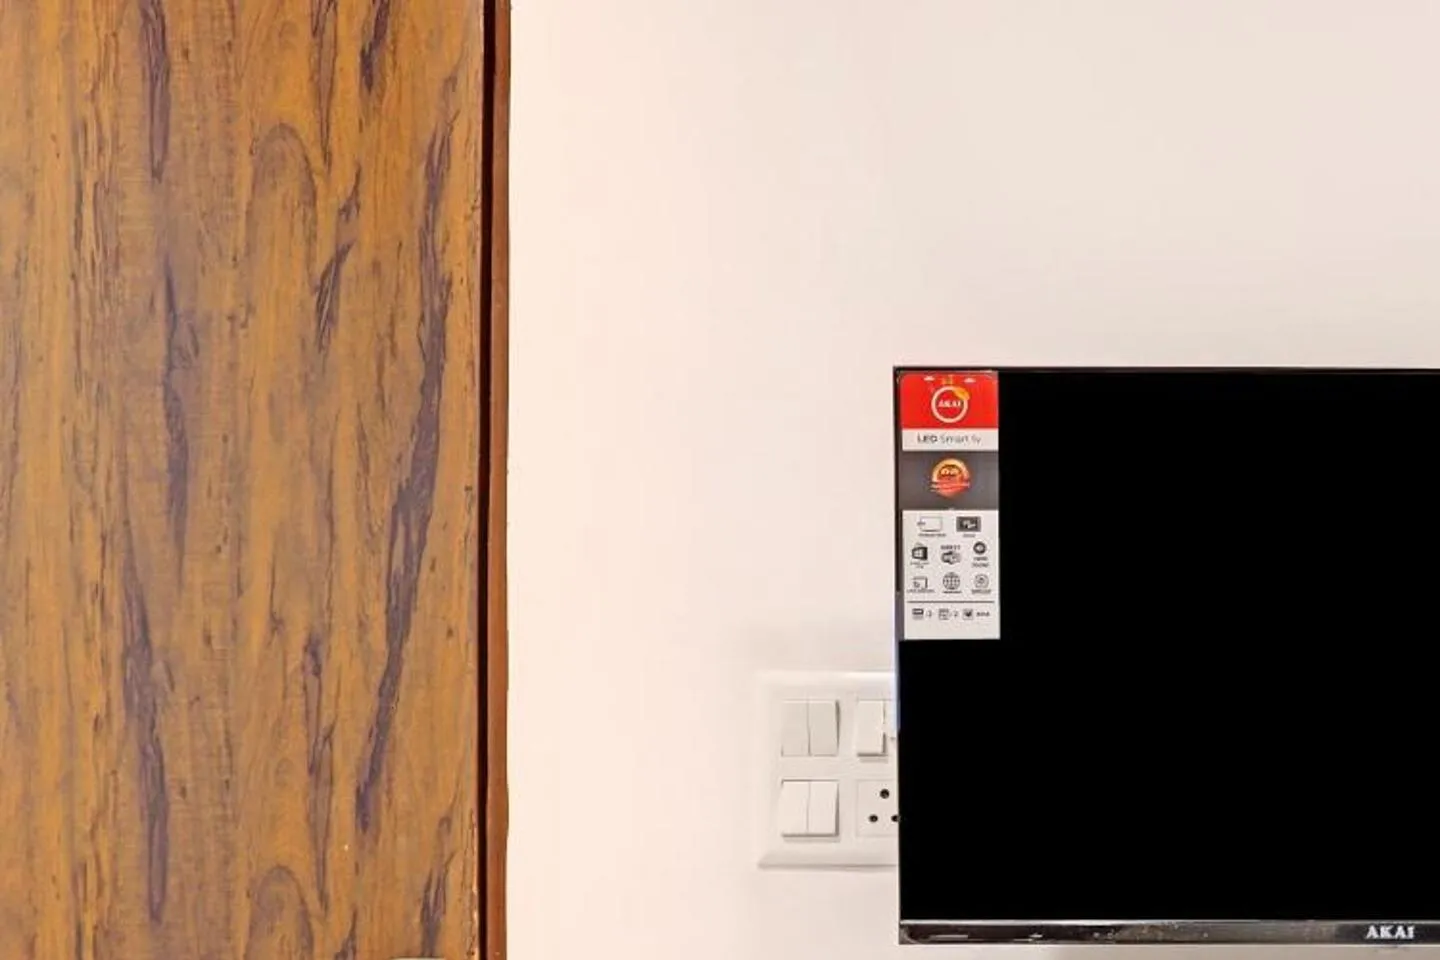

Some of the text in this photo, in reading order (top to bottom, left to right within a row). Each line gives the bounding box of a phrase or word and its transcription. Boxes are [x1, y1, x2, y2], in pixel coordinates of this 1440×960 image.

[937, 399, 961, 408] AKAI
[917, 432, 938, 443] LED
[940, 432, 968, 443] Smart
[1365, 925, 1414, 940] AKAI
